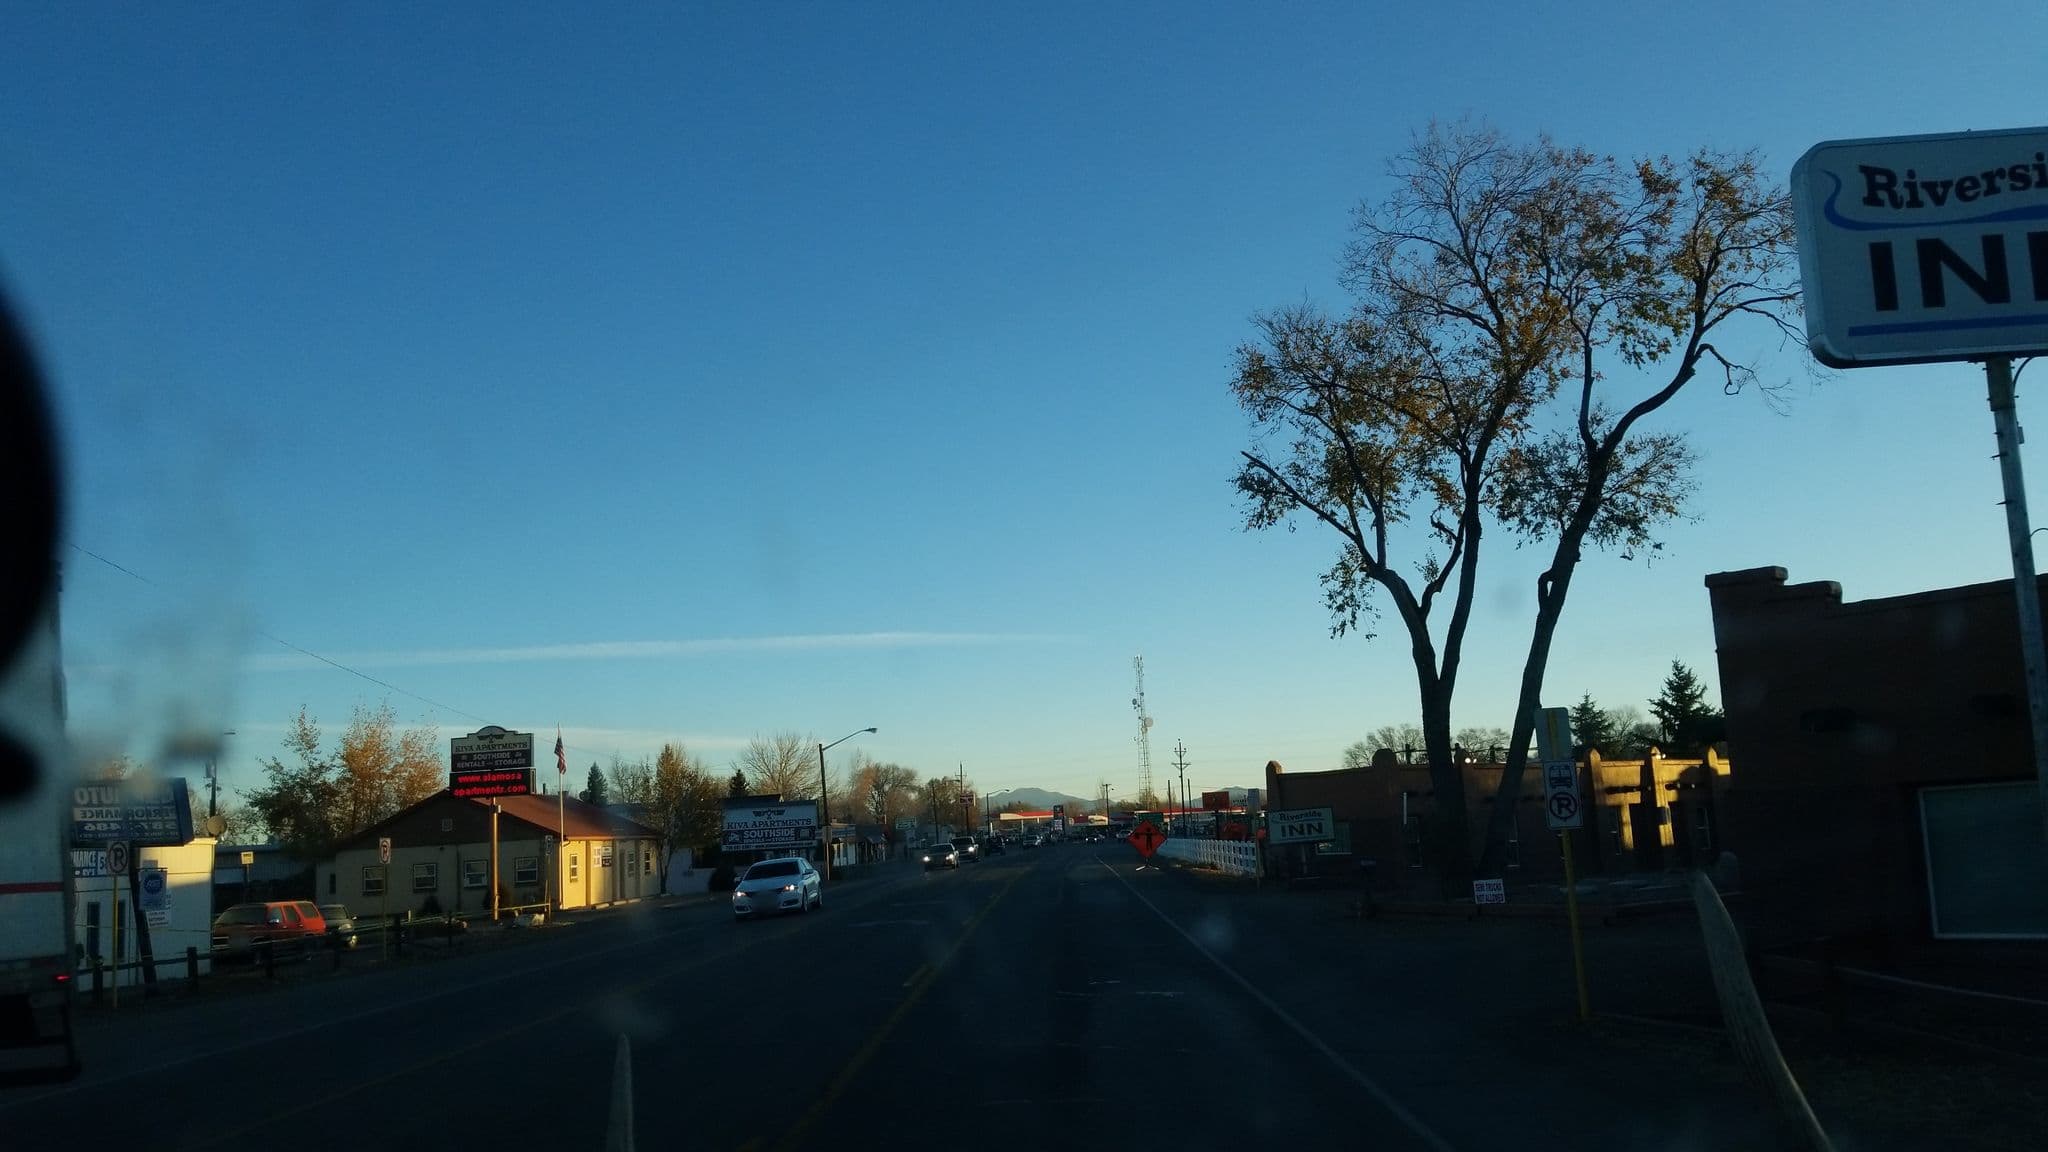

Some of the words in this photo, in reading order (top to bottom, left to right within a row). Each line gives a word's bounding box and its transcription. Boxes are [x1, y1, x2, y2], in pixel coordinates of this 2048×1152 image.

[1869, 231, 2048, 312] IN
[476, 742, 528, 751] APARTMENTS
[473, 752, 511, 761] SOUTHSIDE
[1279, 811, 1322, 821] Riverside
[727, 821, 749, 830] KIVA
[751, 819, 812, 828] APARTMENTS
[743, 829, 796, 838] SOUTHSIDE
[1281, 822, 1323, 838] INN
